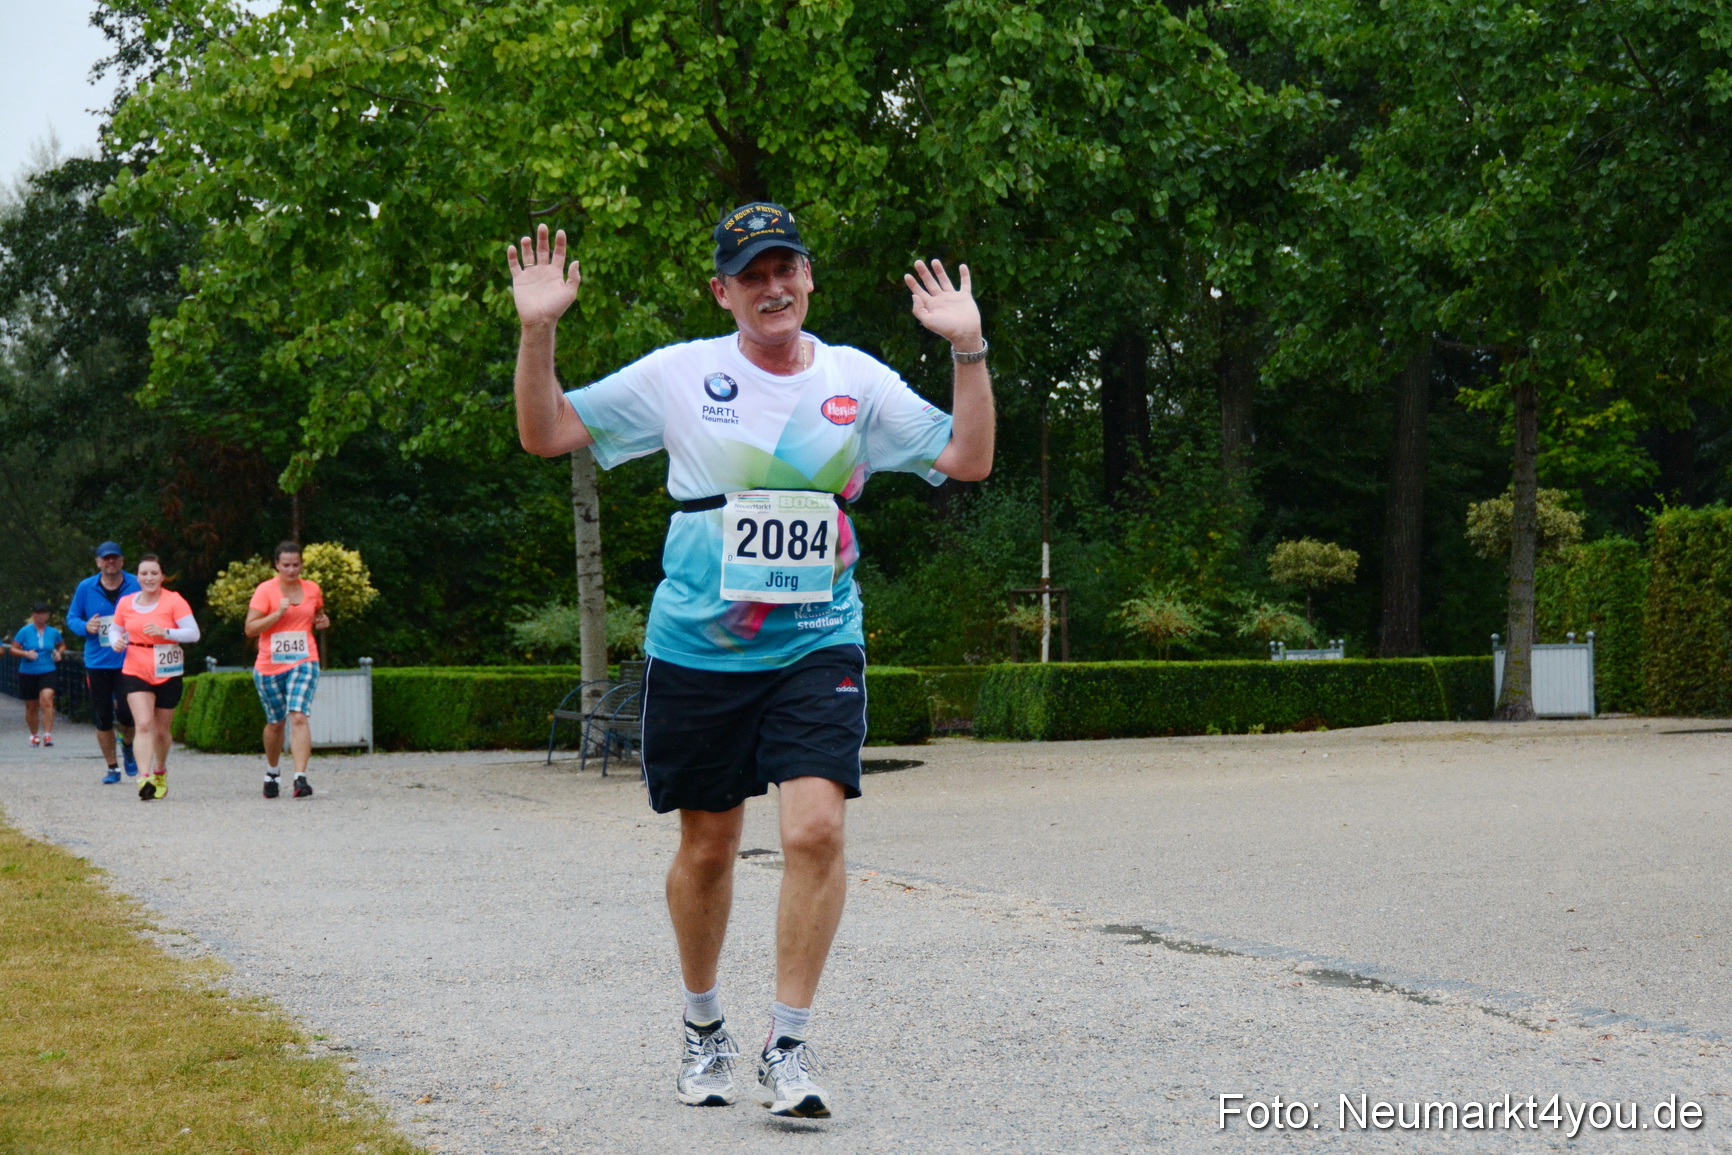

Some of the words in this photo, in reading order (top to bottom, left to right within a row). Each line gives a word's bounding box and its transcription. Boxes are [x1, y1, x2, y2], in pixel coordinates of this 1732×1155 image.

[734, 207, 755, 221] MOUNT
[707, 372, 736, 386] BMW
[702, 405, 739, 418] PARTL
[702, 414, 739, 425] Neumarkt
[779, 496, 831, 509] BOCK
[736, 518, 828, 560] 2084
[765, 571, 799, 591] Jörg
[275, 639, 305, 653] 2648
[835, 685, 859, 693] adidas
